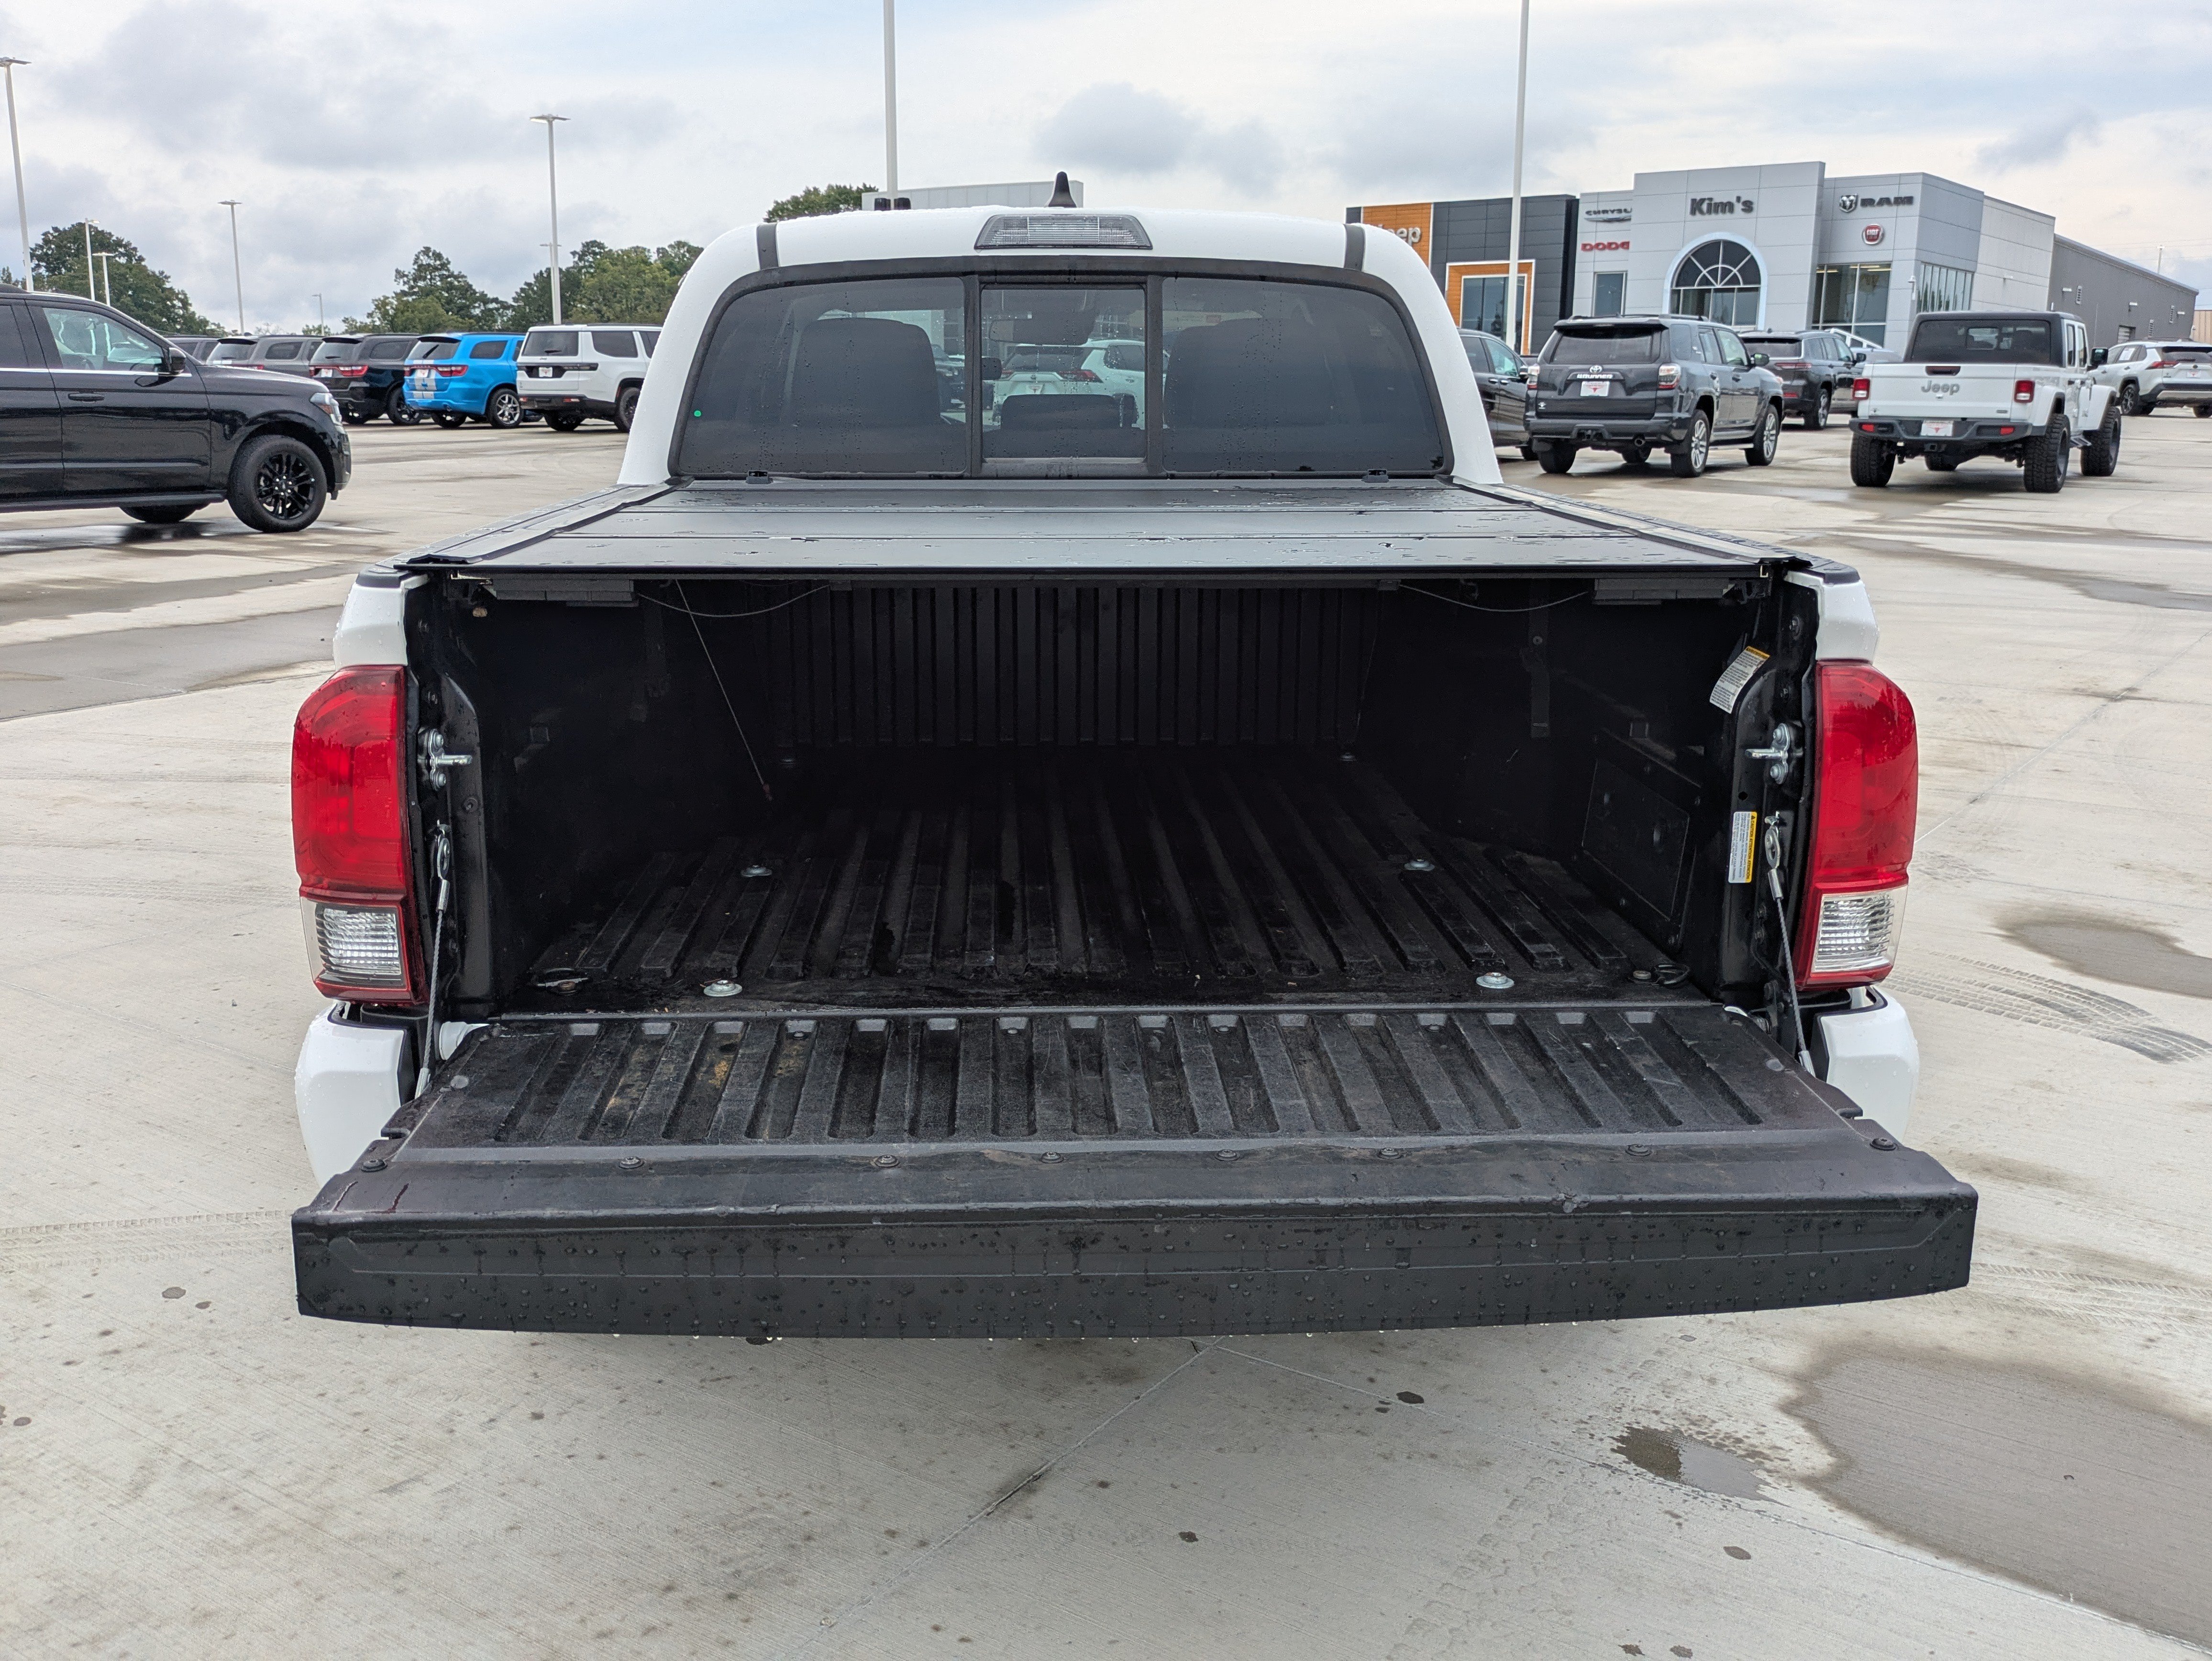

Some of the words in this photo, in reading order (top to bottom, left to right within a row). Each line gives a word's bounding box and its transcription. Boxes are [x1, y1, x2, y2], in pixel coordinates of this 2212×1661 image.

[1690, 196, 1754, 216] Kim's
[1860, 196, 1913, 208] RAM
[1378, 224, 1421, 246] ep
[1921, 380, 1960, 396] Jeep
